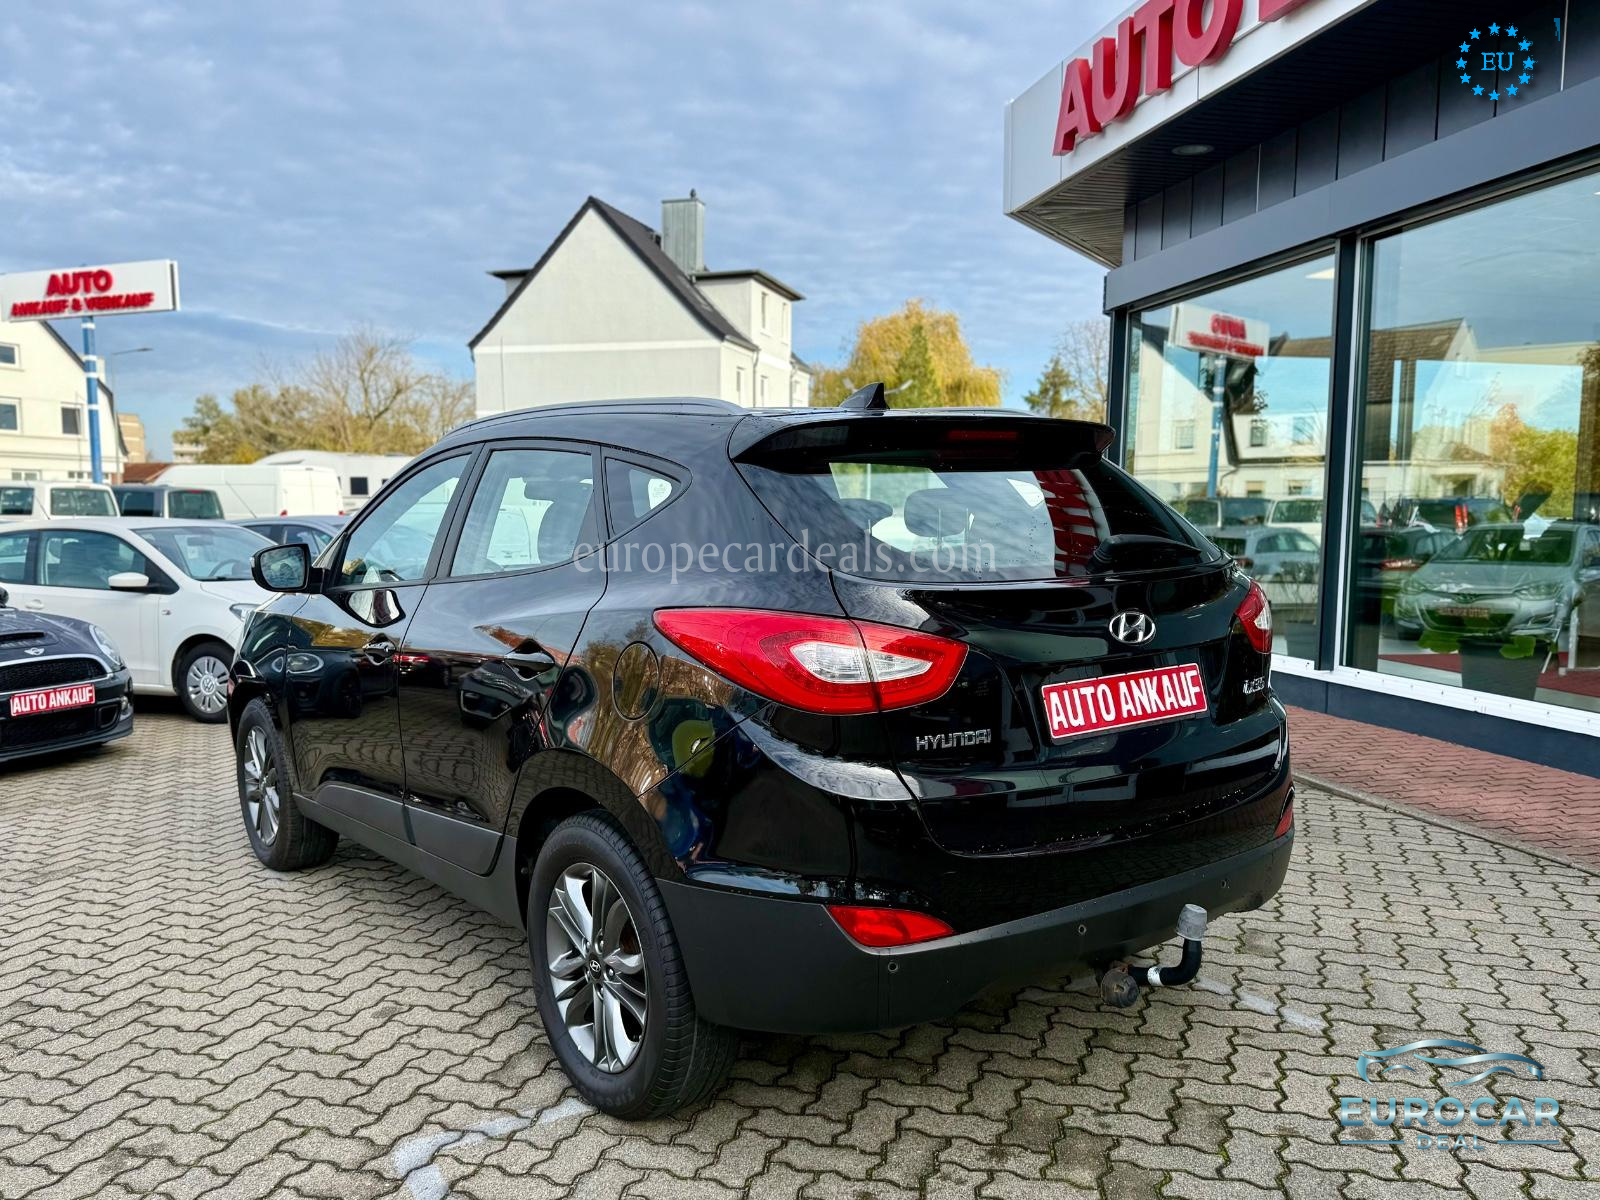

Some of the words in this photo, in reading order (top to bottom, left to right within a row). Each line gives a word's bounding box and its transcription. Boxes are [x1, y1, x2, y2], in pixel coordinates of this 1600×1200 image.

[1053, 0, 1243, 156] AUTO
[46, 270, 113, 296] AUTO
[11, 299, 69, 318] ANKAUF
[71, 297, 82, 311] &
[85, 292, 155, 310] VERKAUF
[13, 694, 47, 713] AUTO
[49, 687, 93, 708] ANKAUF
[1050, 684, 1116, 730] AUTO
[1119, 670, 1200, 718] ANKAUF
[916, 729, 991, 751] HYUNDAI
